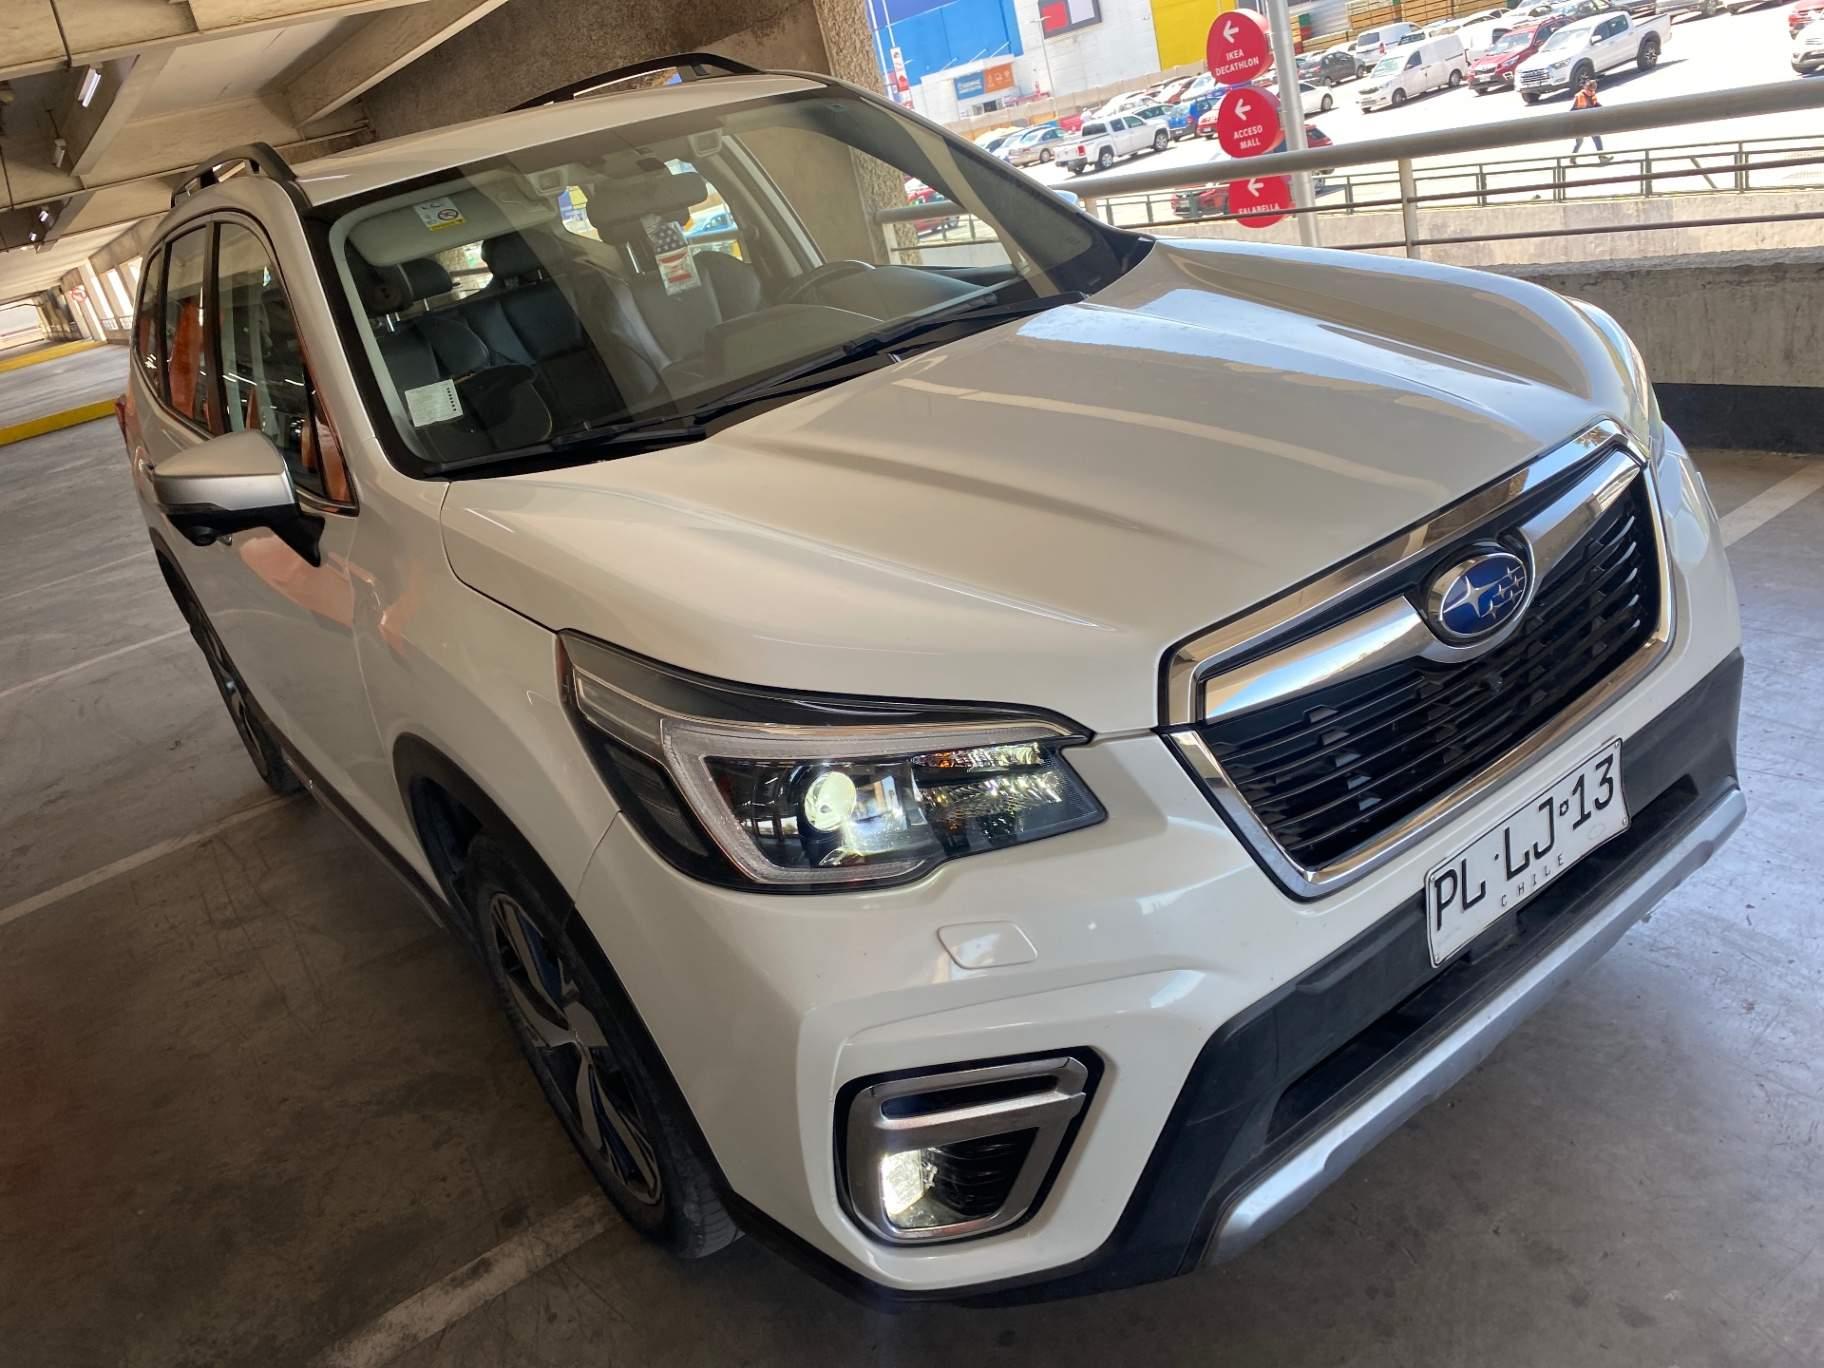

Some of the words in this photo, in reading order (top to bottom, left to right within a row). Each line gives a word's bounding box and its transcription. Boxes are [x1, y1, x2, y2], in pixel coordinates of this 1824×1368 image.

[1226, 49, 1244, 61] IKEA
[1215, 56, 1259, 76] DECATHLON
[1233, 124, 1263, 139] ACCESO
[1240, 138, 1261, 149] MALL
[1501, 853, 1564, 907] CHILE
